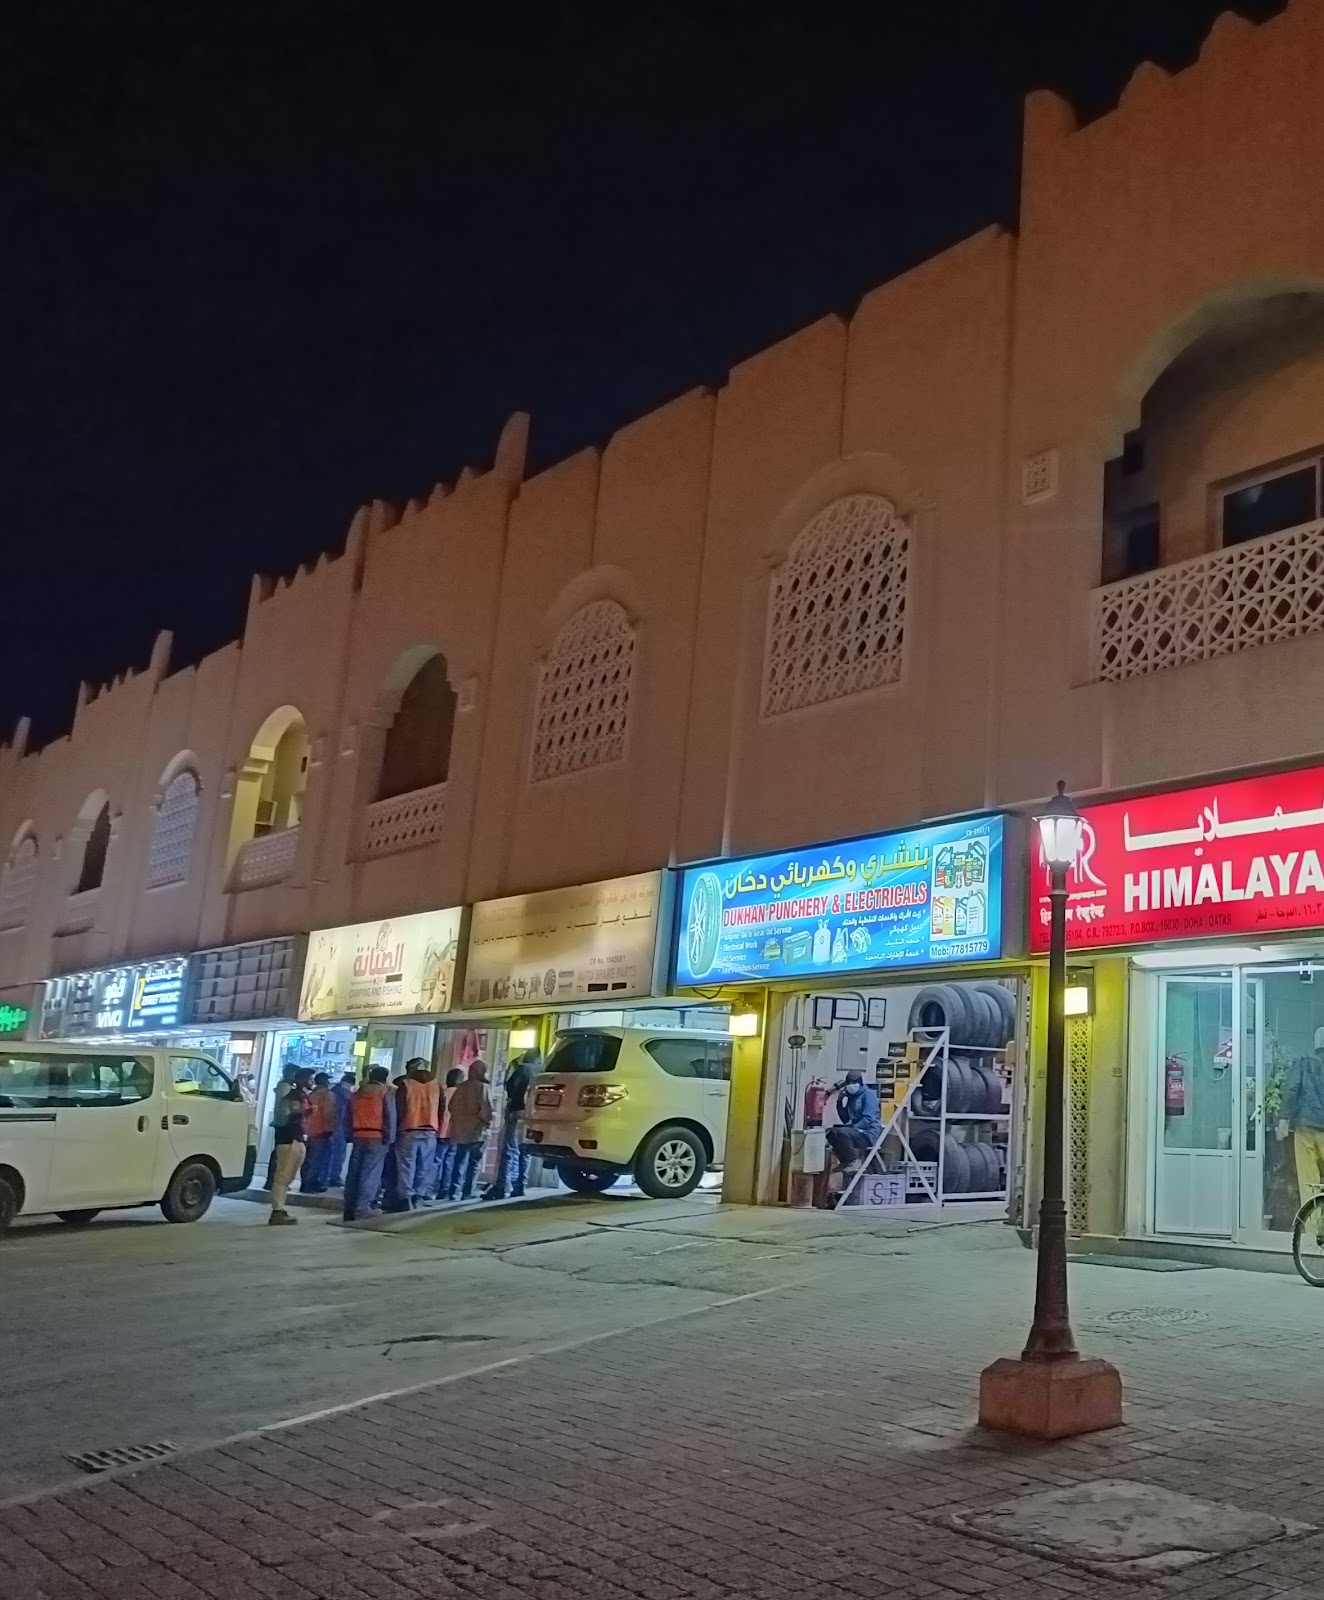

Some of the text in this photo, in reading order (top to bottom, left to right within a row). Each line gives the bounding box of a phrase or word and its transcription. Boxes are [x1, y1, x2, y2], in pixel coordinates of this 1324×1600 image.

[1124, 796, 1324, 856] ملايا
[725, 839, 929, 899] بنشري وكهربائي دخان
[1124, 849, 1324, 912] HIMALAYA
[723, 881, 928, 928] DUKHAN PUNCHERY & ELECTRICALS
[1184, 917, 1203, 929] DOHA
[1209, 913, 1232, 927] QATAR
[773, 926, 793, 935] Service
[723, 940, 758, 952] Electrical Work
[931, 940, 988, 956] Mob: 77815779
[577, 965, 637, 981] AUTO SPARE PARTS
[349, 985, 402, 999] CAMPING AND FISHING
